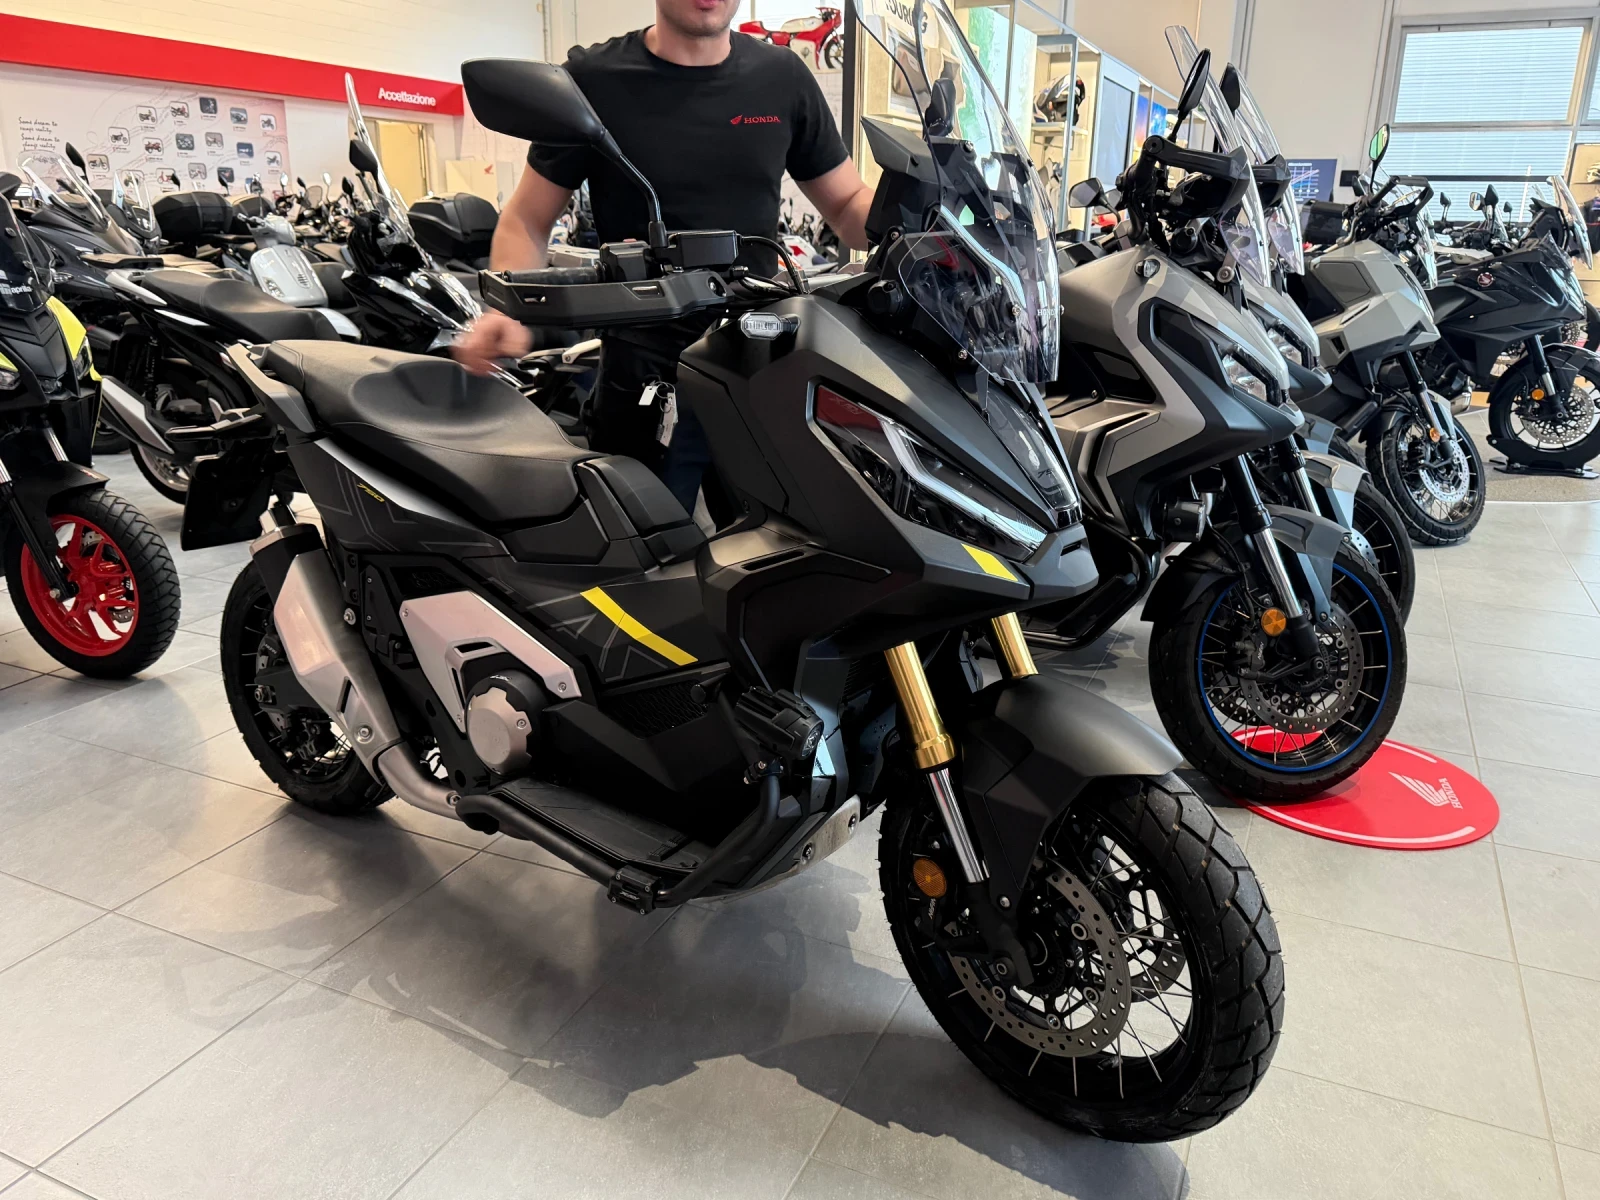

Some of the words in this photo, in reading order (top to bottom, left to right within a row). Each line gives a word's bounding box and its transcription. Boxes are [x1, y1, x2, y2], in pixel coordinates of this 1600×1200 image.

[378, 87, 436, 106] Accettazione
[743, 115, 782, 124] HONDA
[11, 283, 33, 294] aprilia
[357, 482, 385, 502] 750
[1438, 777, 1463, 809] HONDA
